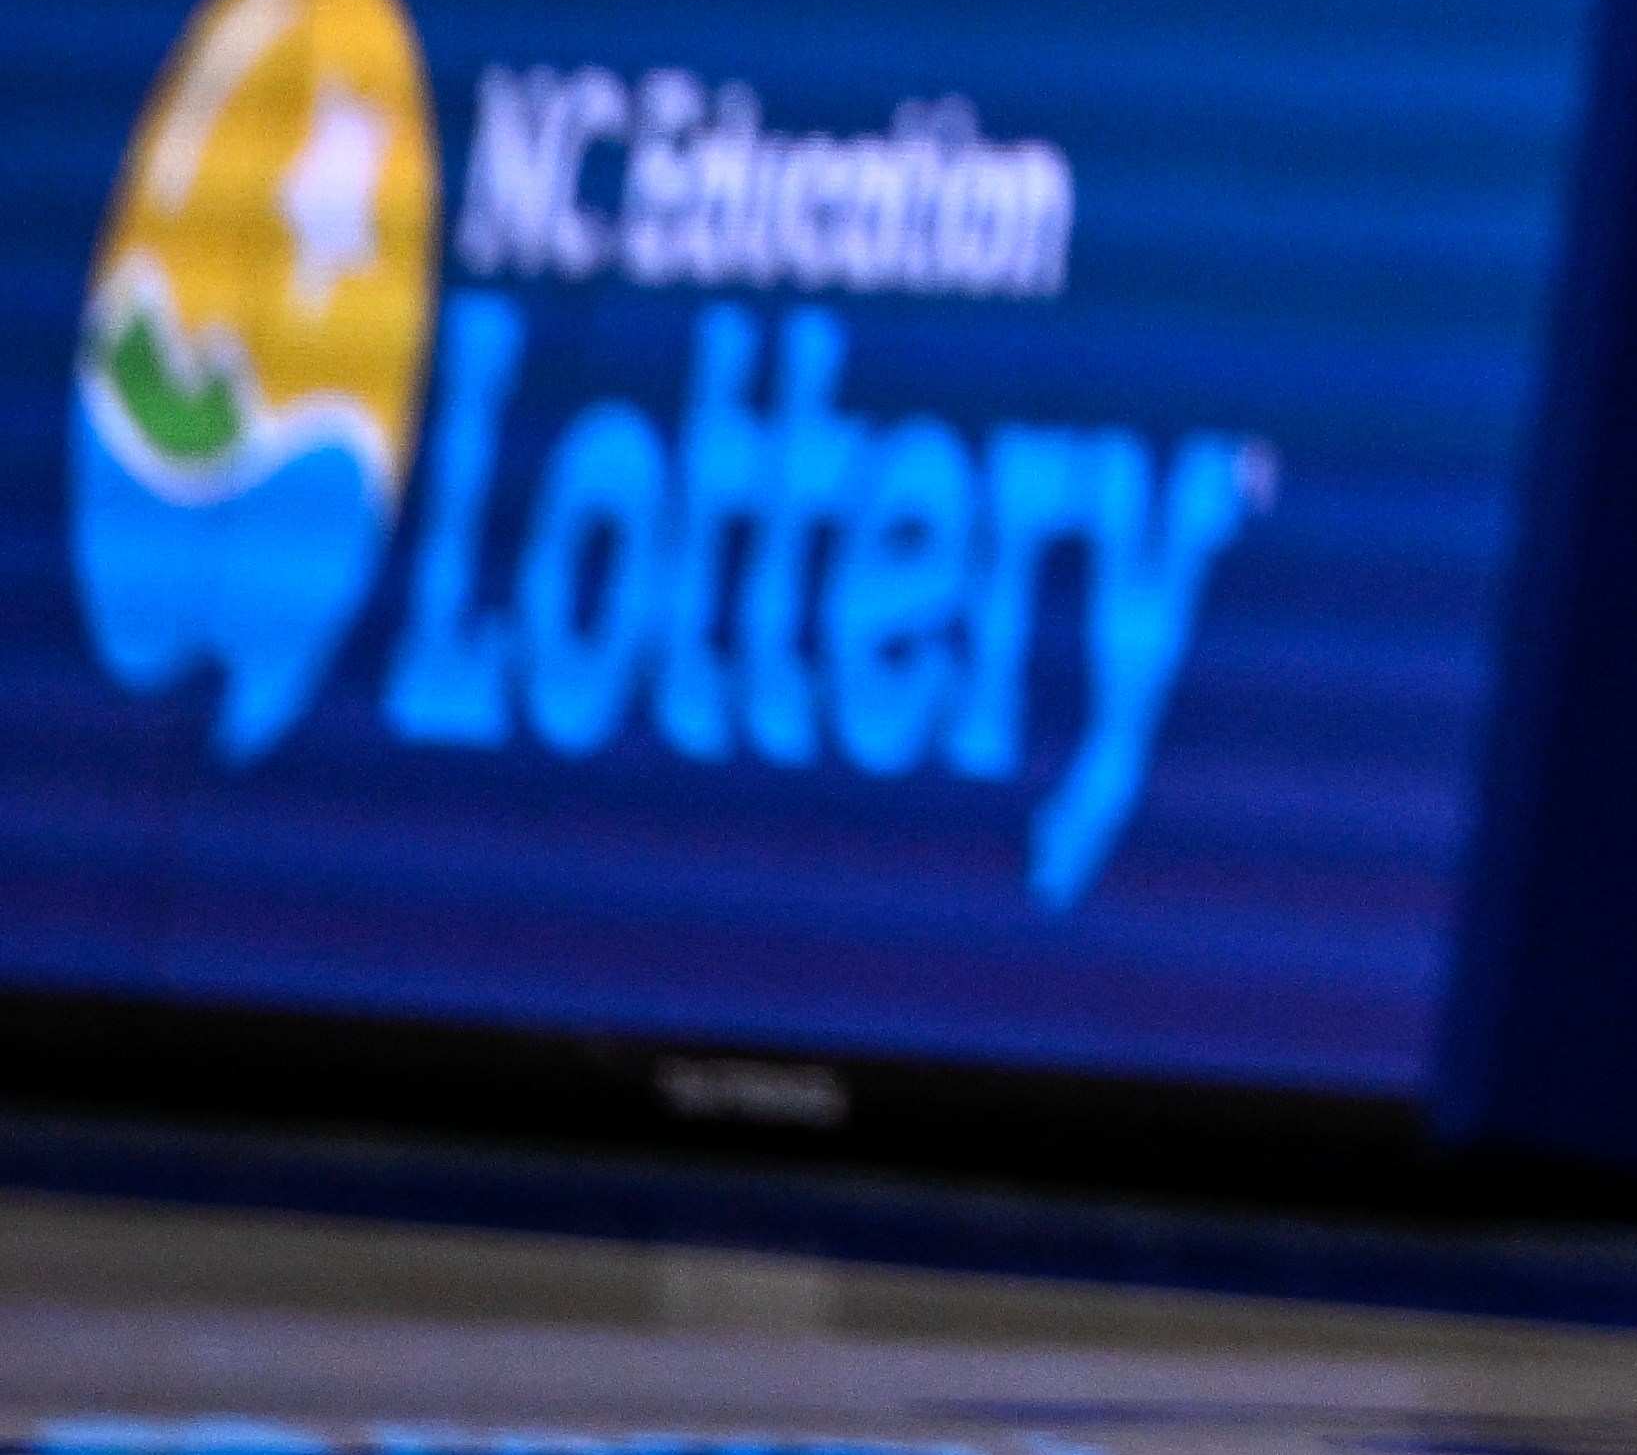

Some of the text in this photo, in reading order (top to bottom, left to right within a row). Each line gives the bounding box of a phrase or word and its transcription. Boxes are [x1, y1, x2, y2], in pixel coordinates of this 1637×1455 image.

[453, 62, 1075, 298] NC Education
[385, 290, 1250, 916] Lottery
